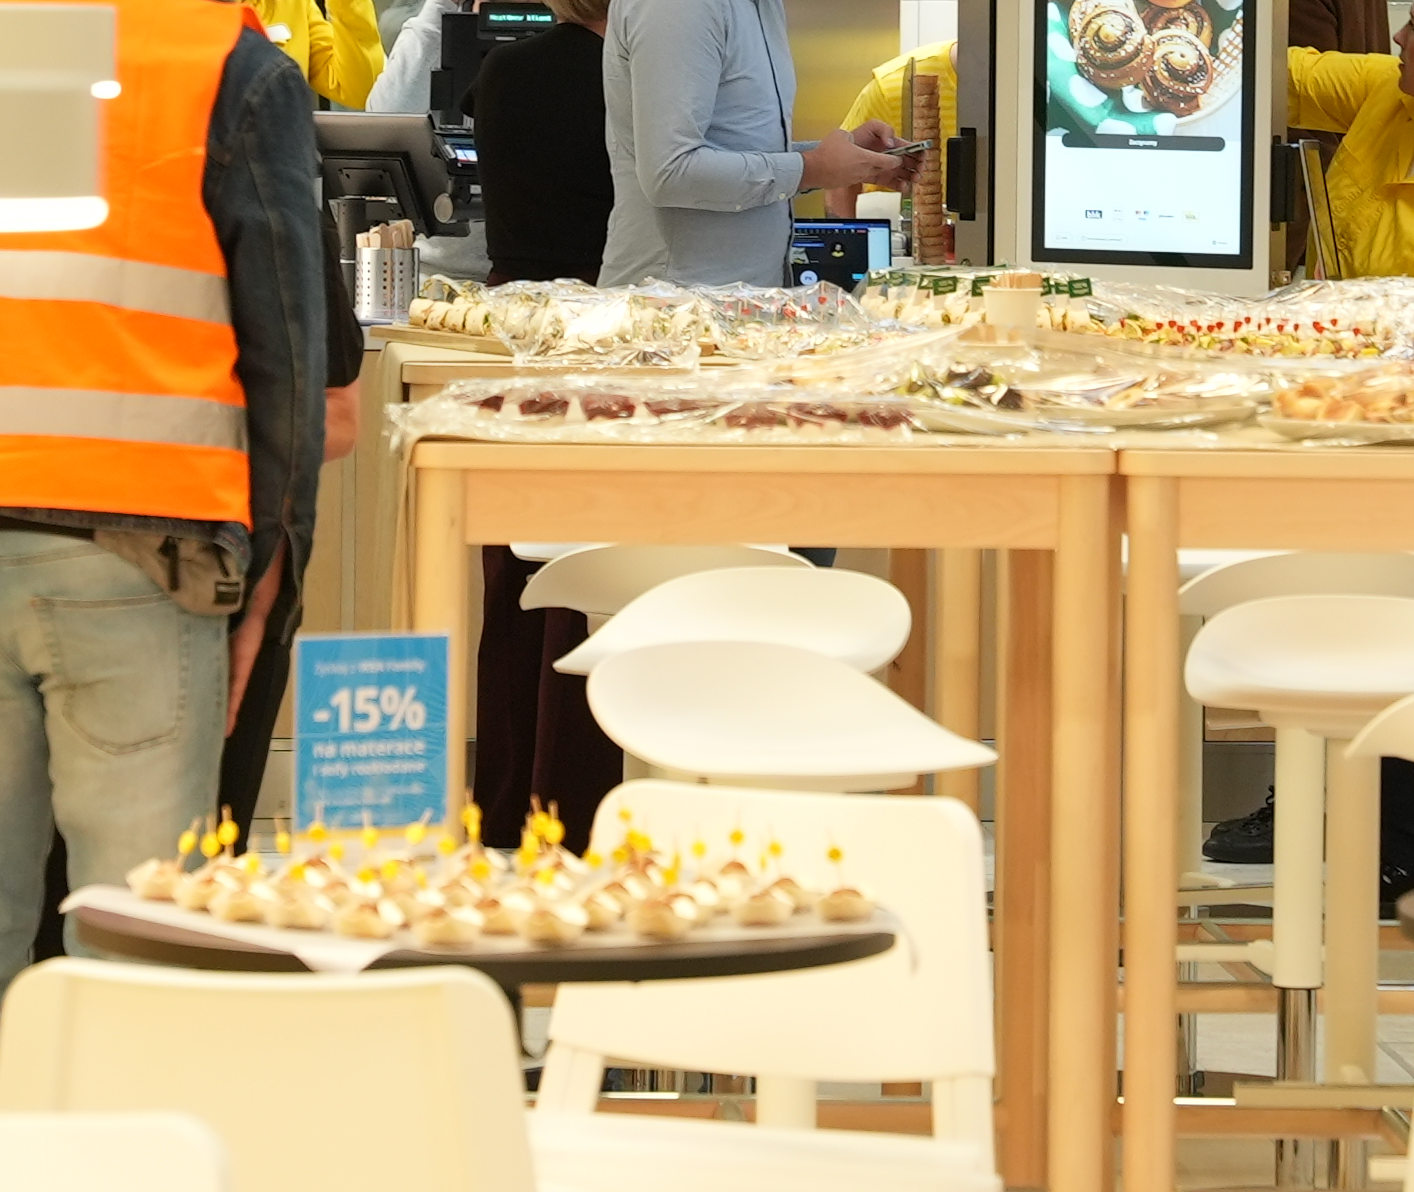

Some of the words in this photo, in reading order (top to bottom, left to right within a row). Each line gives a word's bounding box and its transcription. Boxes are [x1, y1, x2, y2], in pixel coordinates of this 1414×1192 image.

[312, 684, 427, 735] -15%
[312, 743, 336, 759] na
[339, 739, 426, 757] materace
